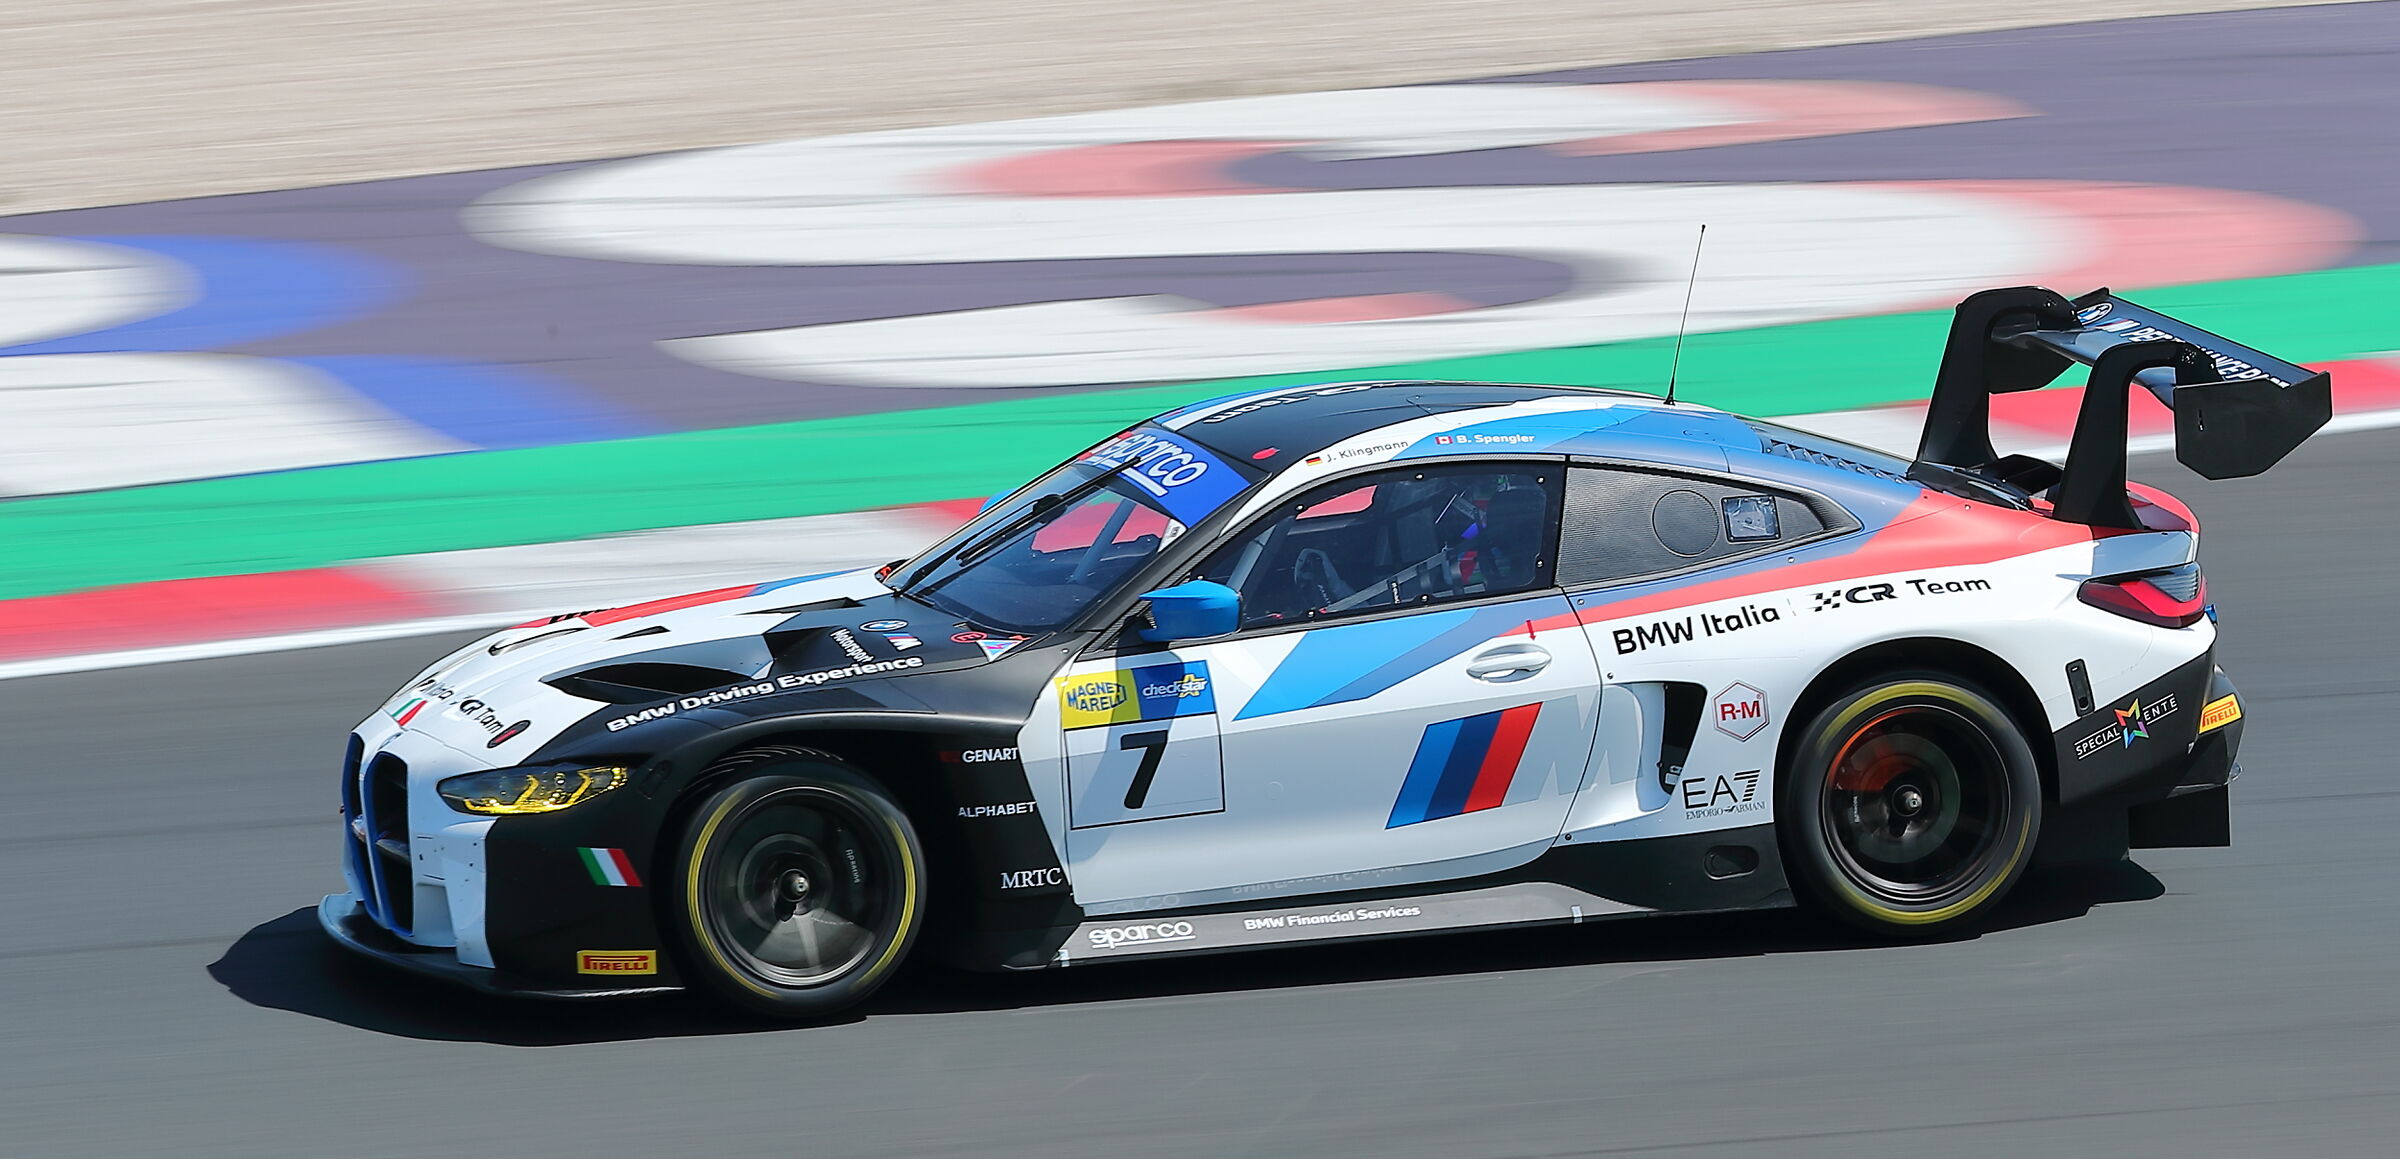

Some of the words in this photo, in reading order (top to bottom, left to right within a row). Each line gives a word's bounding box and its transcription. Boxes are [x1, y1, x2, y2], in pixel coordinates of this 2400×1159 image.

[1326, 454, 1338, 463] J.
[1339, 440, 1409, 459] Klingmann
[1456, 434, 1472, 444] B.
[1474, 434, 1536, 445] Spengler
[1612, 616, 1694, 655] BMW
[1701, 604, 1780, 637] Italia
[1906, 577, 1992, 596] Team
[829, 628, 875, 664] Motorsport
[606, 703, 676, 732] BMW
[680, 683, 775, 711] Driving
[777, 656, 924, 689] Experience
[1142, 681, 1208, 696] checkstar
[2202, 700, 2238, 727] PIRELLI
[962, 747, 1019, 763] GENART
[2075, 727, 2121, 757] SPECIAL
[1120, 729, 1169, 810] 7
[1682, 769, 1761, 809] EA7
[958, 801, 1037, 818] ALPHABET
[1686, 806, 1723, 820] EMPORIO
[1734, 801, 1766, 814] ARMANI
[1001, 867, 1062, 889] MRTC
[1243, 917, 1284, 931] BMW
[1287, 911, 1355, 928] Financial
[1357, 905, 1421, 922] Services
[1089, 921, 1194, 949] sparco
[583, 954, 648, 971] PIRELLI
